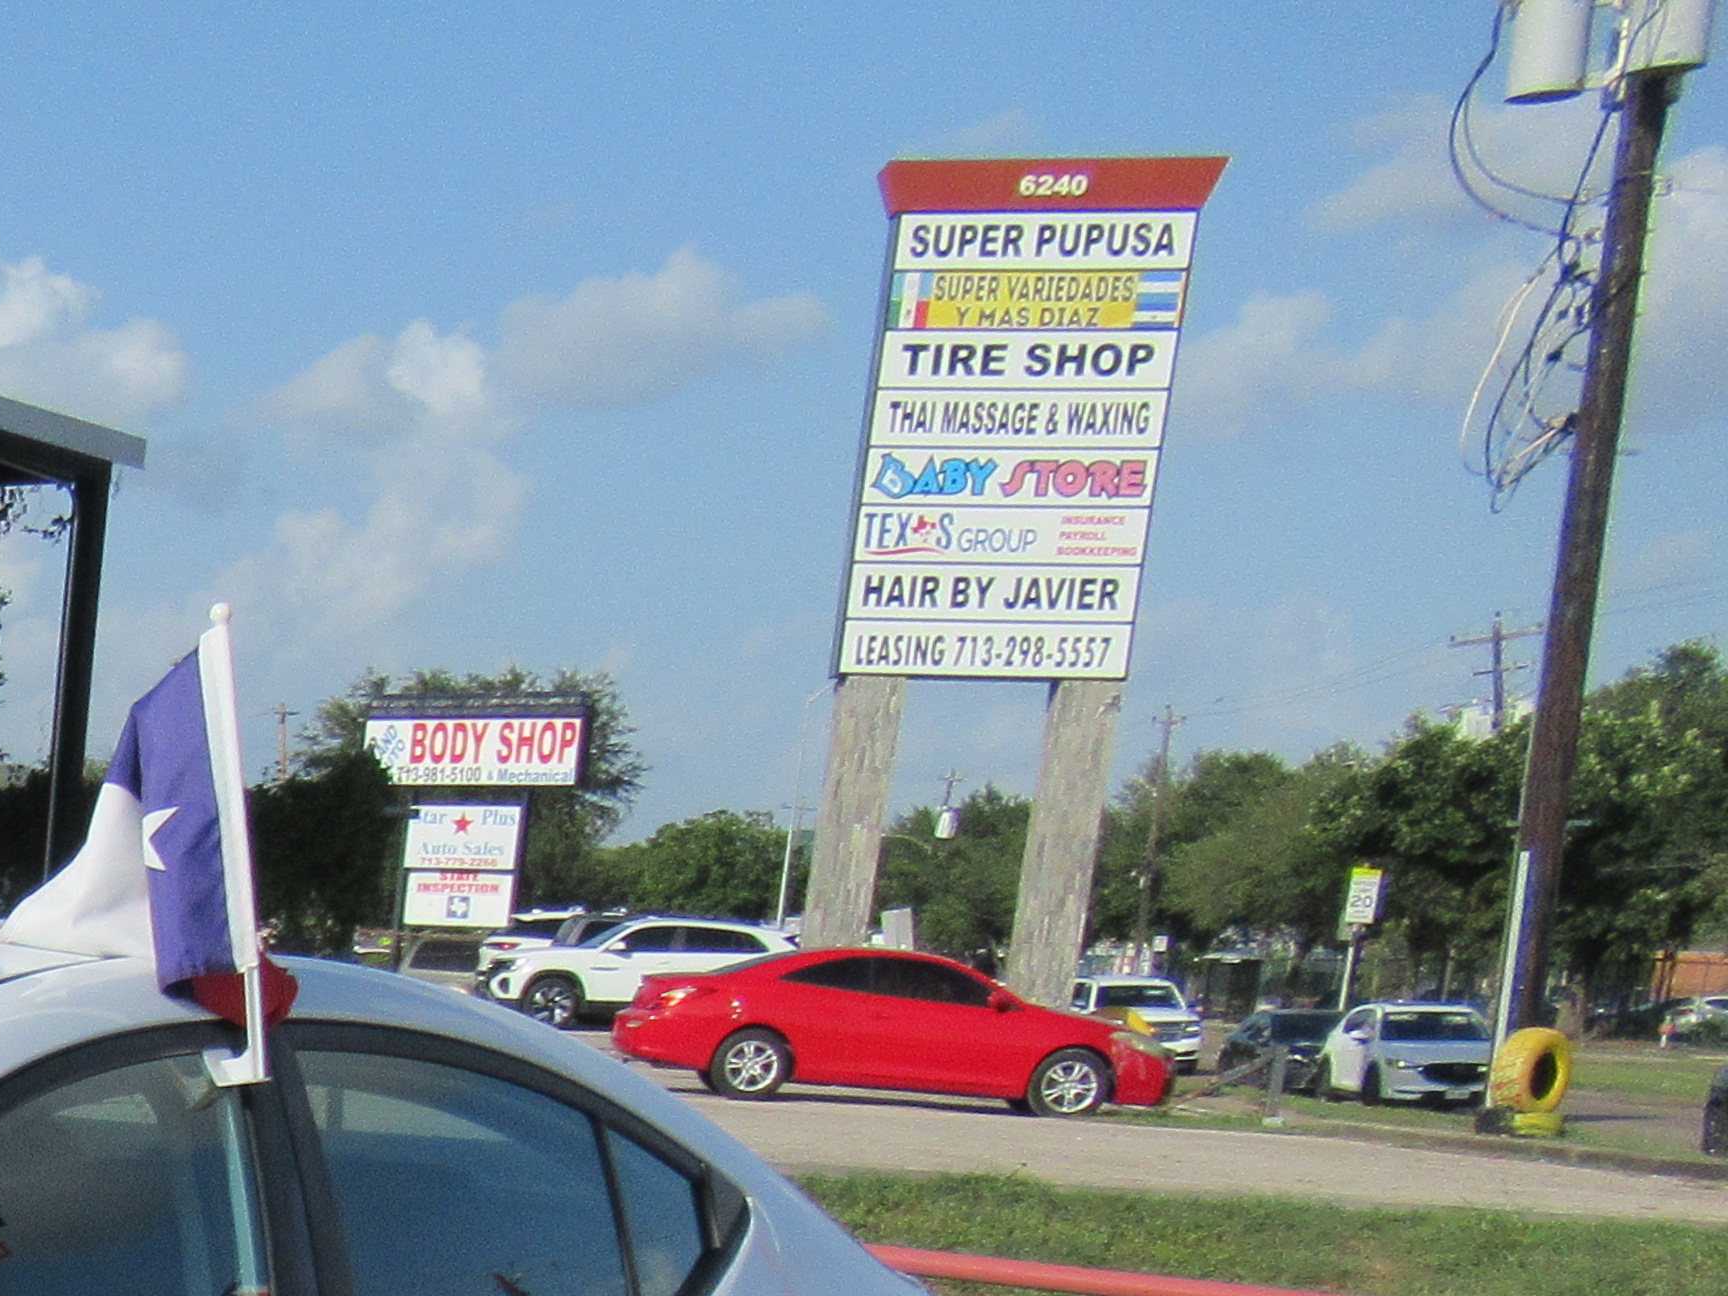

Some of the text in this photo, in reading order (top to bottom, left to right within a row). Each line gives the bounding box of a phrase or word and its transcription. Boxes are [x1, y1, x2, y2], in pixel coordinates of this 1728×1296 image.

[1018, 174, 1089, 197] 6240
[909, 223, 1176, 258] SUPER PUPUSA
[933, 275, 1134, 304] SUPER VARIEDADES
[956, 306, 1102, 328] Y MAS DIAZ
[901, 343, 1155, 378] TIRE SHOP
[889, 400, 1151, 436] THAI MASSAGE & WAXING
[872, 452, 1148, 501] BABY STORE
[957, 528, 1038, 553] GROUP
[861, 575, 1120, 611] HAIR BY JAVIER
[854, 635, 1113, 669] LEASING 713-298-5557
[409, 721, 577, 765] BODY SHOP
[397, 766, 483, 783] 713-981-5100
[496, 768, 574, 783] Mechanical
[482, 809, 516, 826] Plus
[418, 841, 505, 856] Auto Sales
[418, 883, 501, 893] INSPECTION
